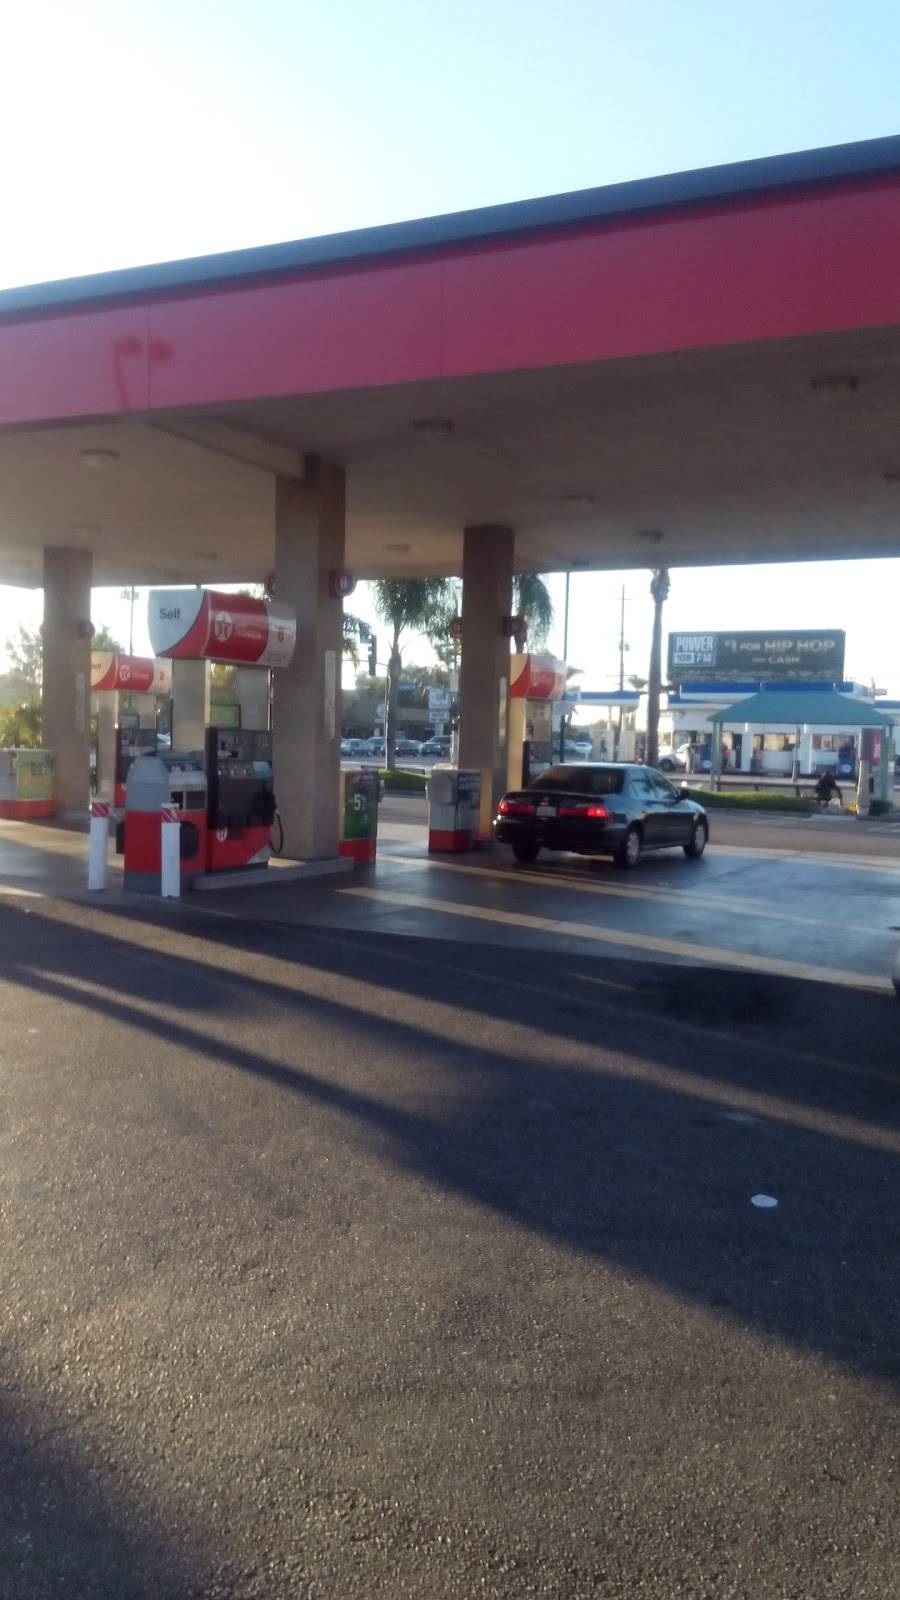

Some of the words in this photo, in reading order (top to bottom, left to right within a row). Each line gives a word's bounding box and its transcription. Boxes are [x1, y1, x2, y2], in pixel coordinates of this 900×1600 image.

[159, 607, 181, 620] Self
[676, 636, 713, 652] POWER
[740, 642, 760, 651] FOR
[764, 639, 793, 652] HIP
[797, 639, 835, 652] HOP
[696, 652, 712, 663] FM
